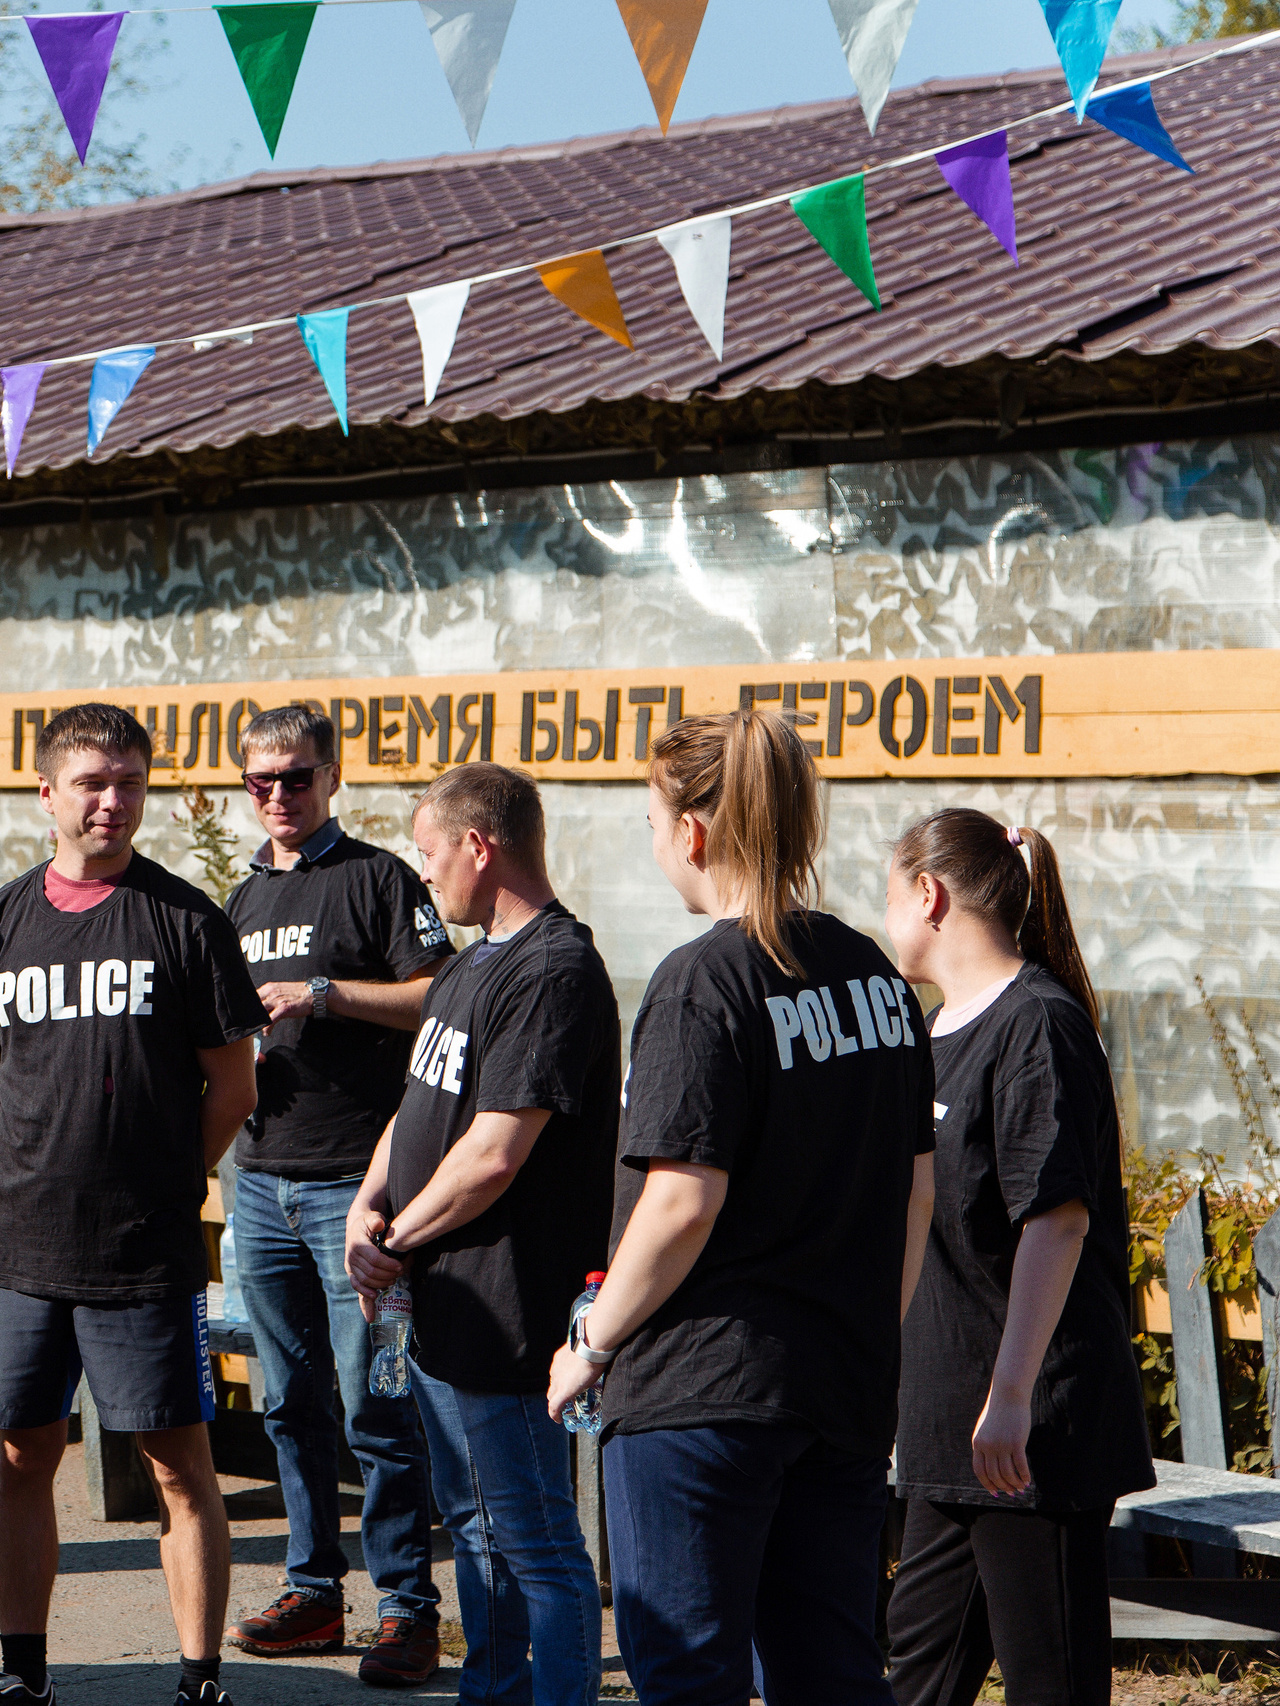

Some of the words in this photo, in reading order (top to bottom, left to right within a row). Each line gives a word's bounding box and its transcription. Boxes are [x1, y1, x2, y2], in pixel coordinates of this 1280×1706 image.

[13, 702, 262, 771] ПШЛО
[290, 693, 496, 766] РЕМЯ
[414, 903, 442, 931] 48
[765, 975, 916, 1070] POLICE
[196, 1293, 213, 1394] HOLLISTER
